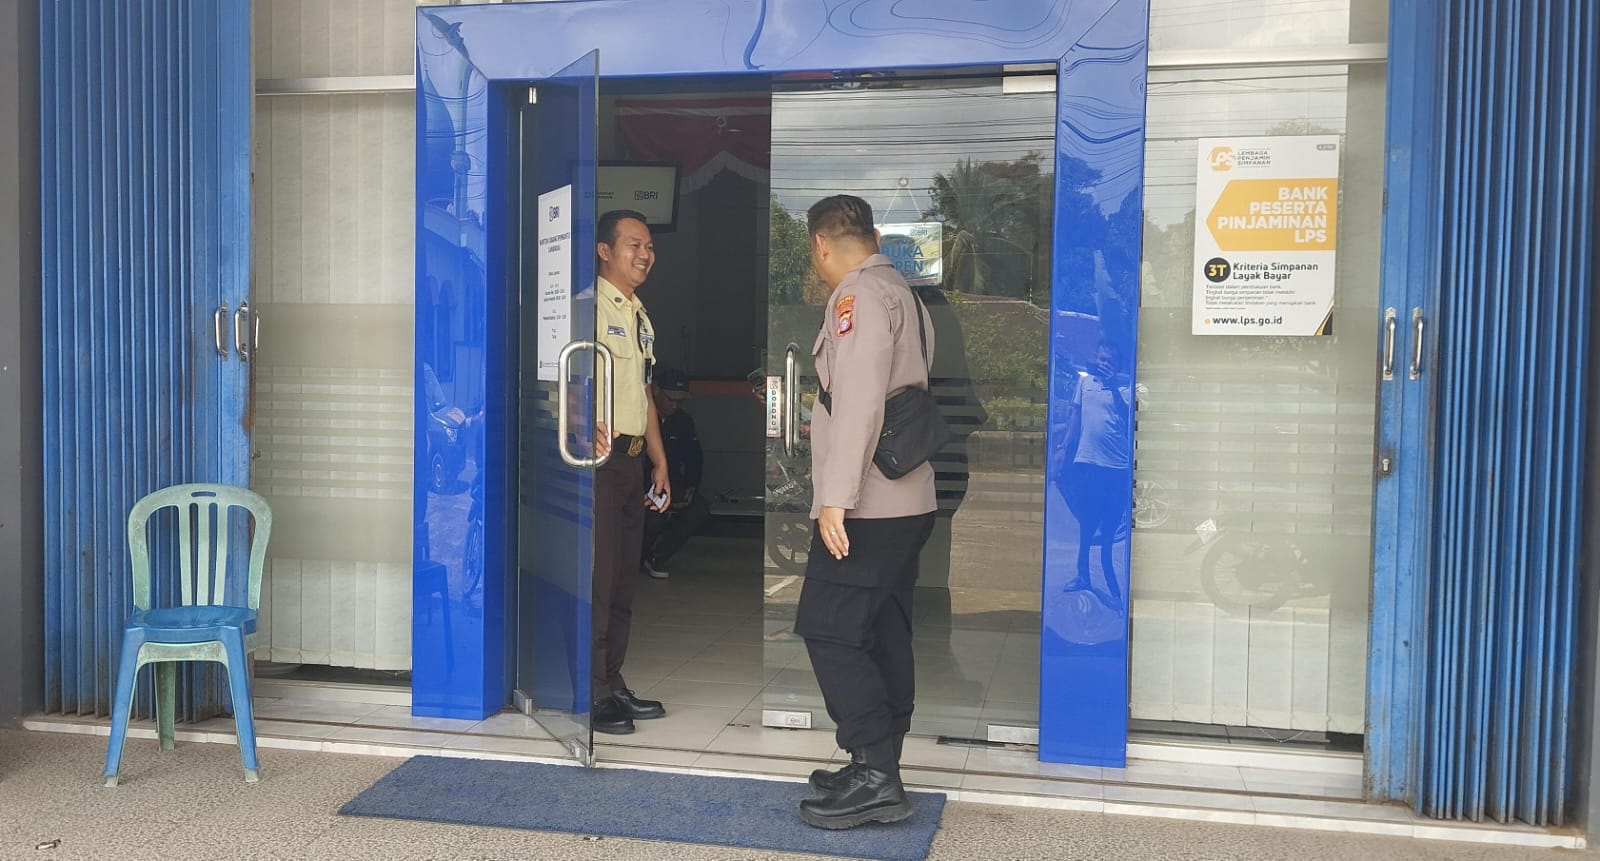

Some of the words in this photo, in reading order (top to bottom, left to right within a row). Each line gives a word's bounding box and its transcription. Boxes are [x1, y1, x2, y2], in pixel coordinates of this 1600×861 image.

[643, 191, 658, 200] BRI
[1278, 186, 1328, 200] BANK
[1249, 201, 1328, 215] PESERTA
[1217, 215, 1328, 230] PINJAMINAN
[1295, 229, 1327, 243] LPS
[881, 245, 924, 258] BUKA
[894, 260, 924, 273] PEN
[1208, 264, 1227, 277] 3T
[1233, 262, 1268, 271] Kriteria
[1271, 262, 1318, 273] Simpanan
[1233, 271, 1261, 281] Layak
[1263, 271, 1292, 281] Bayar
[1212, 316, 1283, 326] www.lps.go.id
